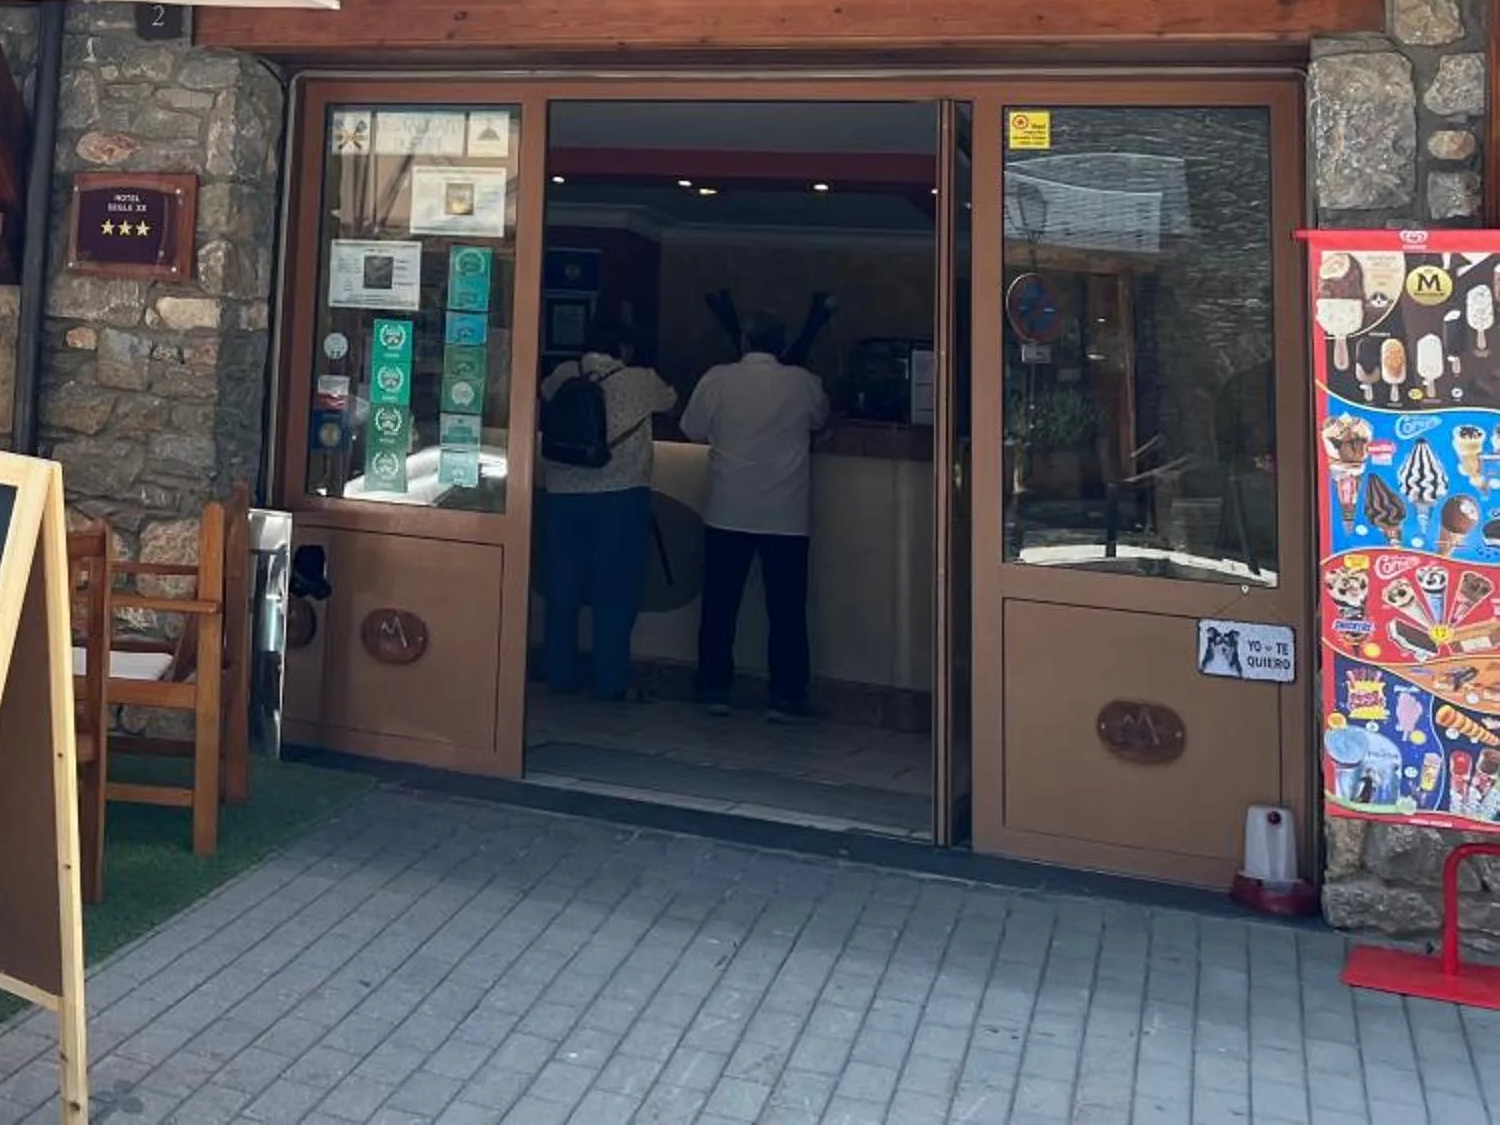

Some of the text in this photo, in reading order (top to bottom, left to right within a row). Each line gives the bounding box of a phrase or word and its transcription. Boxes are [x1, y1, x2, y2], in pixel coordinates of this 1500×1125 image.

[151, 4, 165, 27] 2
[1417, 273, 1442, 291] M
[1247, 640, 1289, 655] YO TE
[1247, 655, 1290, 670] QUIERO
